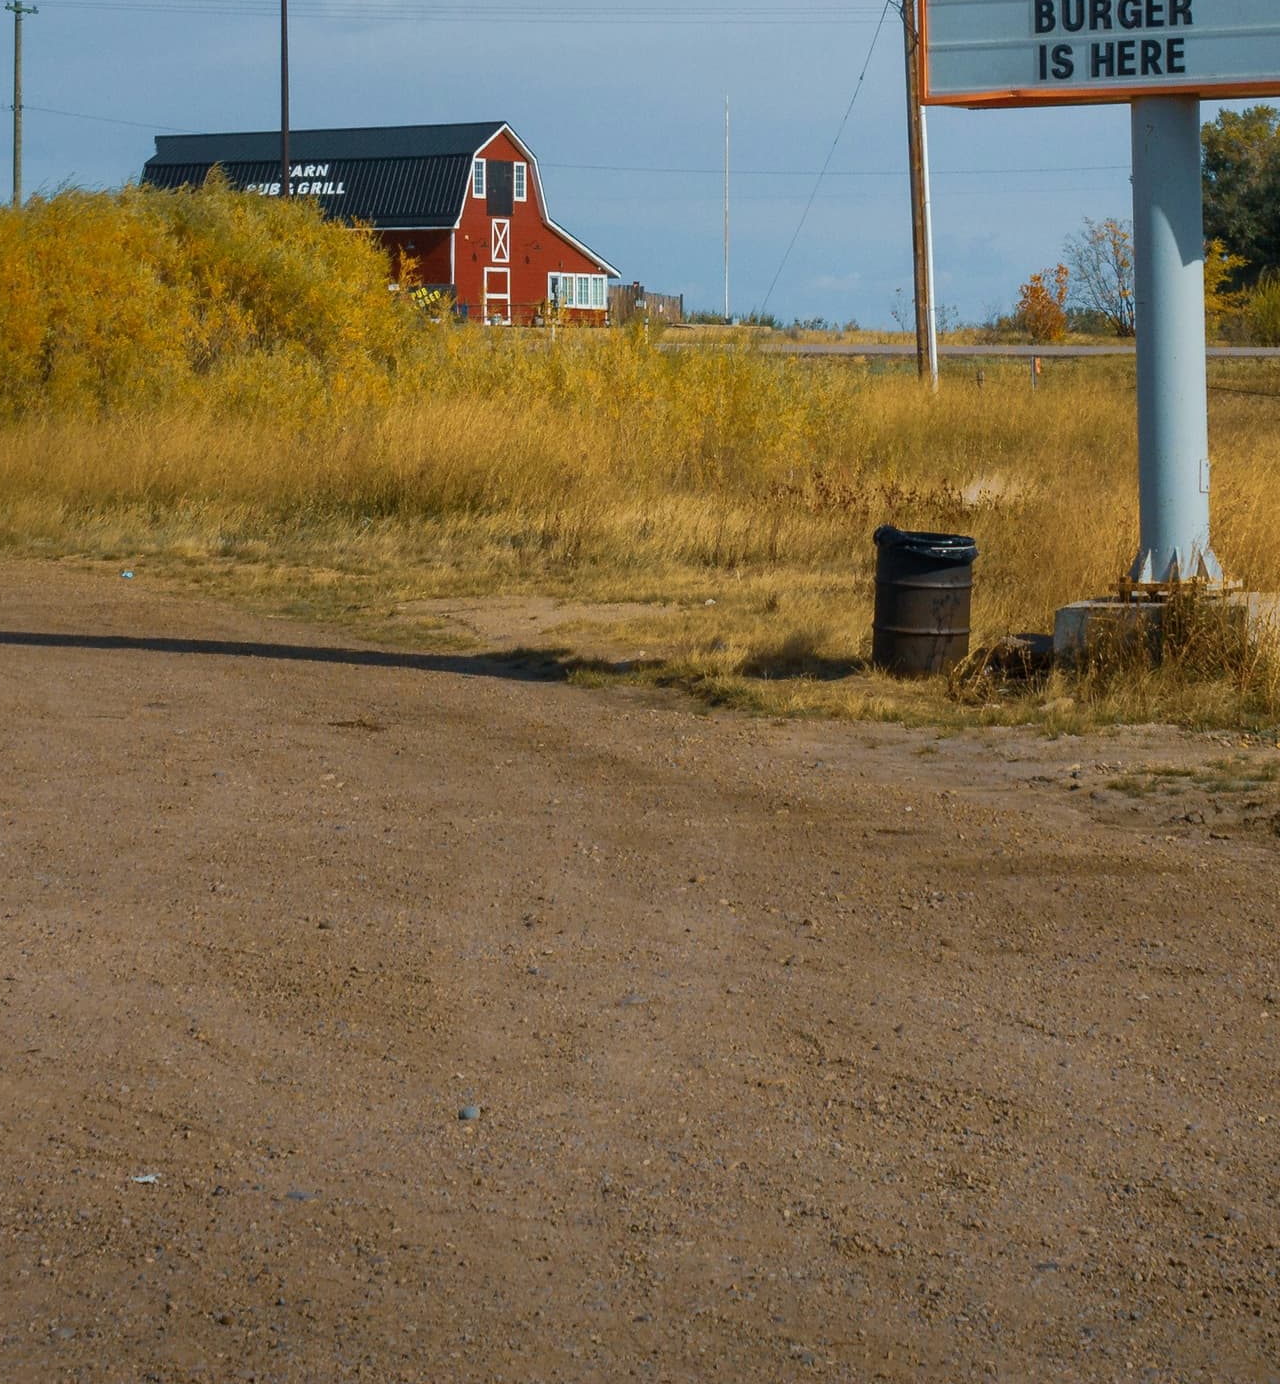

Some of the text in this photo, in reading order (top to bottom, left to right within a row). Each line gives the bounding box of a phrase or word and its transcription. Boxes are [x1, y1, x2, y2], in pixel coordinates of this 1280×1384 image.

[1039, 37, 1186, 80] IS HERE
[297, 181, 345, 195] GRILL
